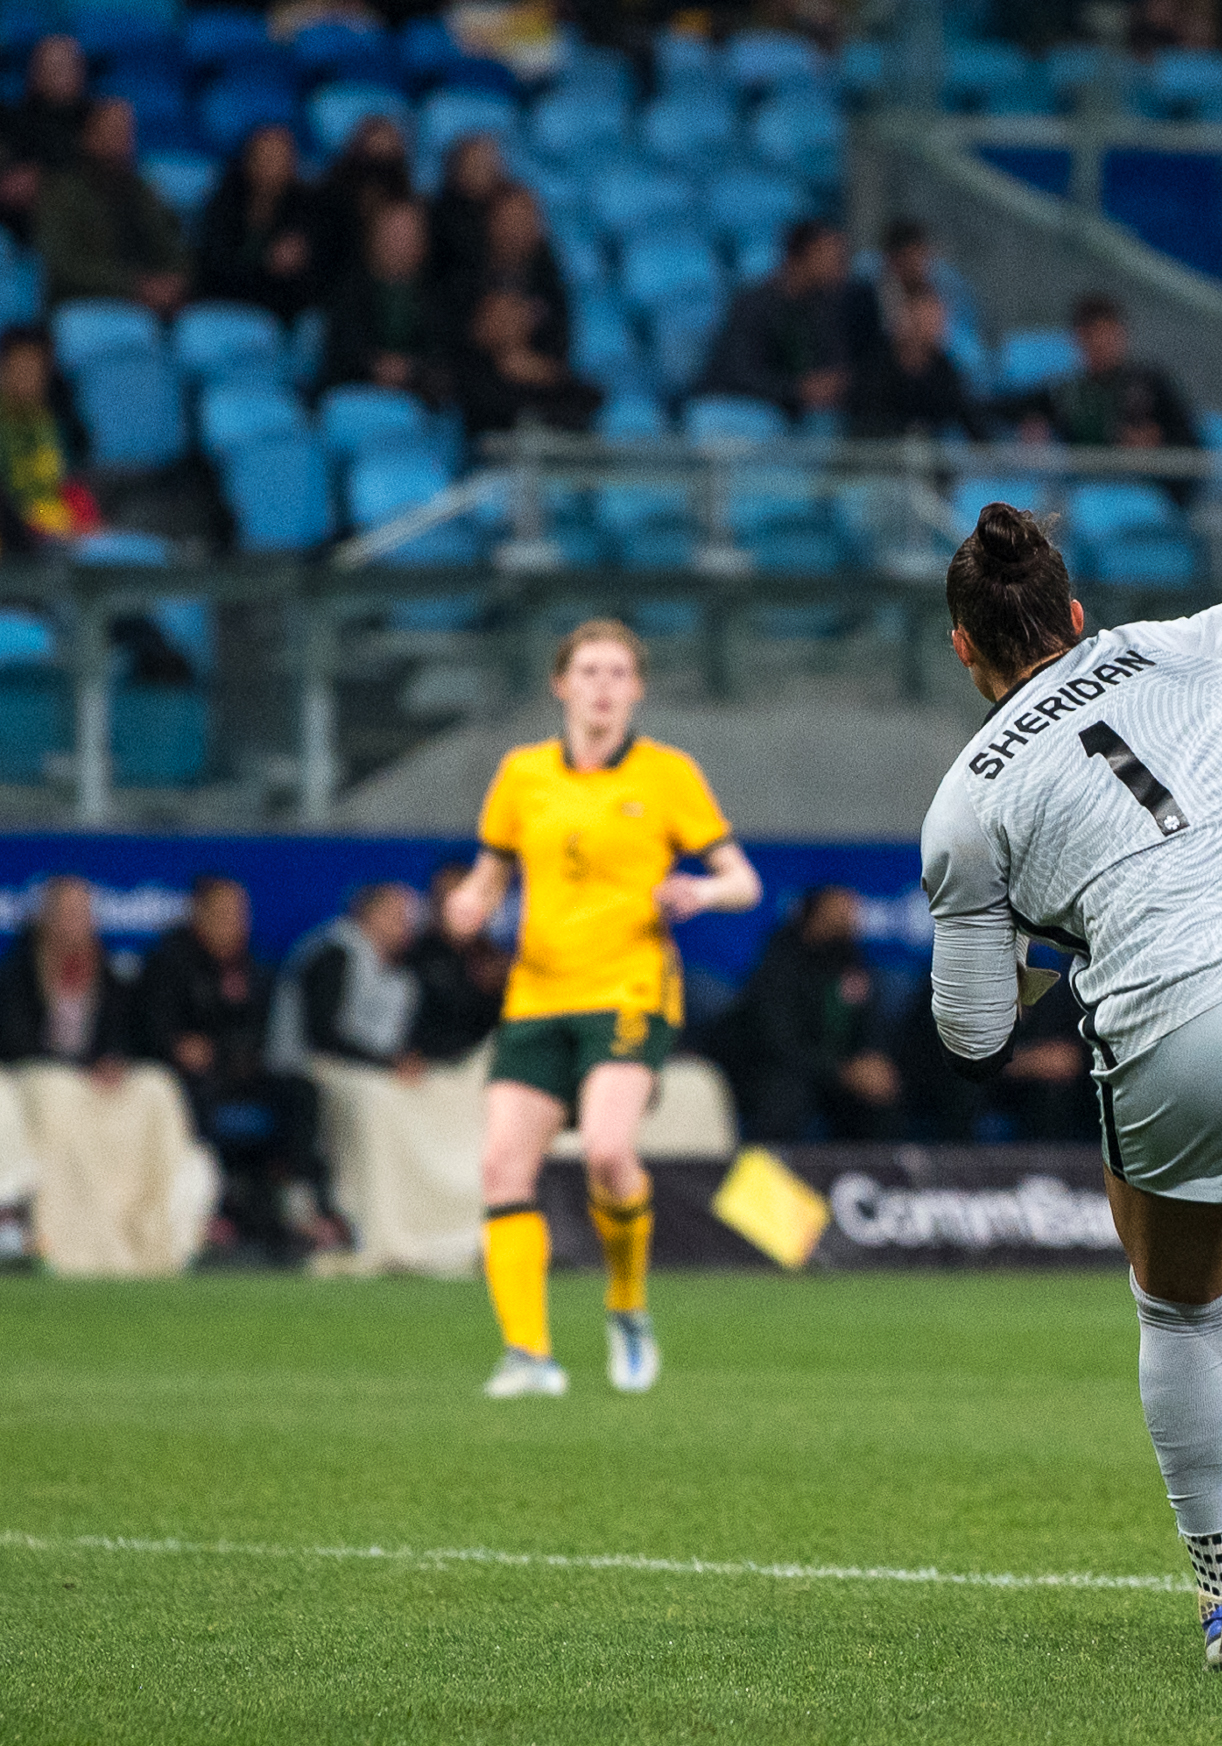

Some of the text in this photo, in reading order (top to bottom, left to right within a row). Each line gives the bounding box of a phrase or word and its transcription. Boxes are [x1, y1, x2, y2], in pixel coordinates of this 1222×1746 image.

[968, 649, 1157, 780] SHERIDAN
[1077, 719, 1191, 838] 1
[829, 1173, 1121, 1247] CommBa
